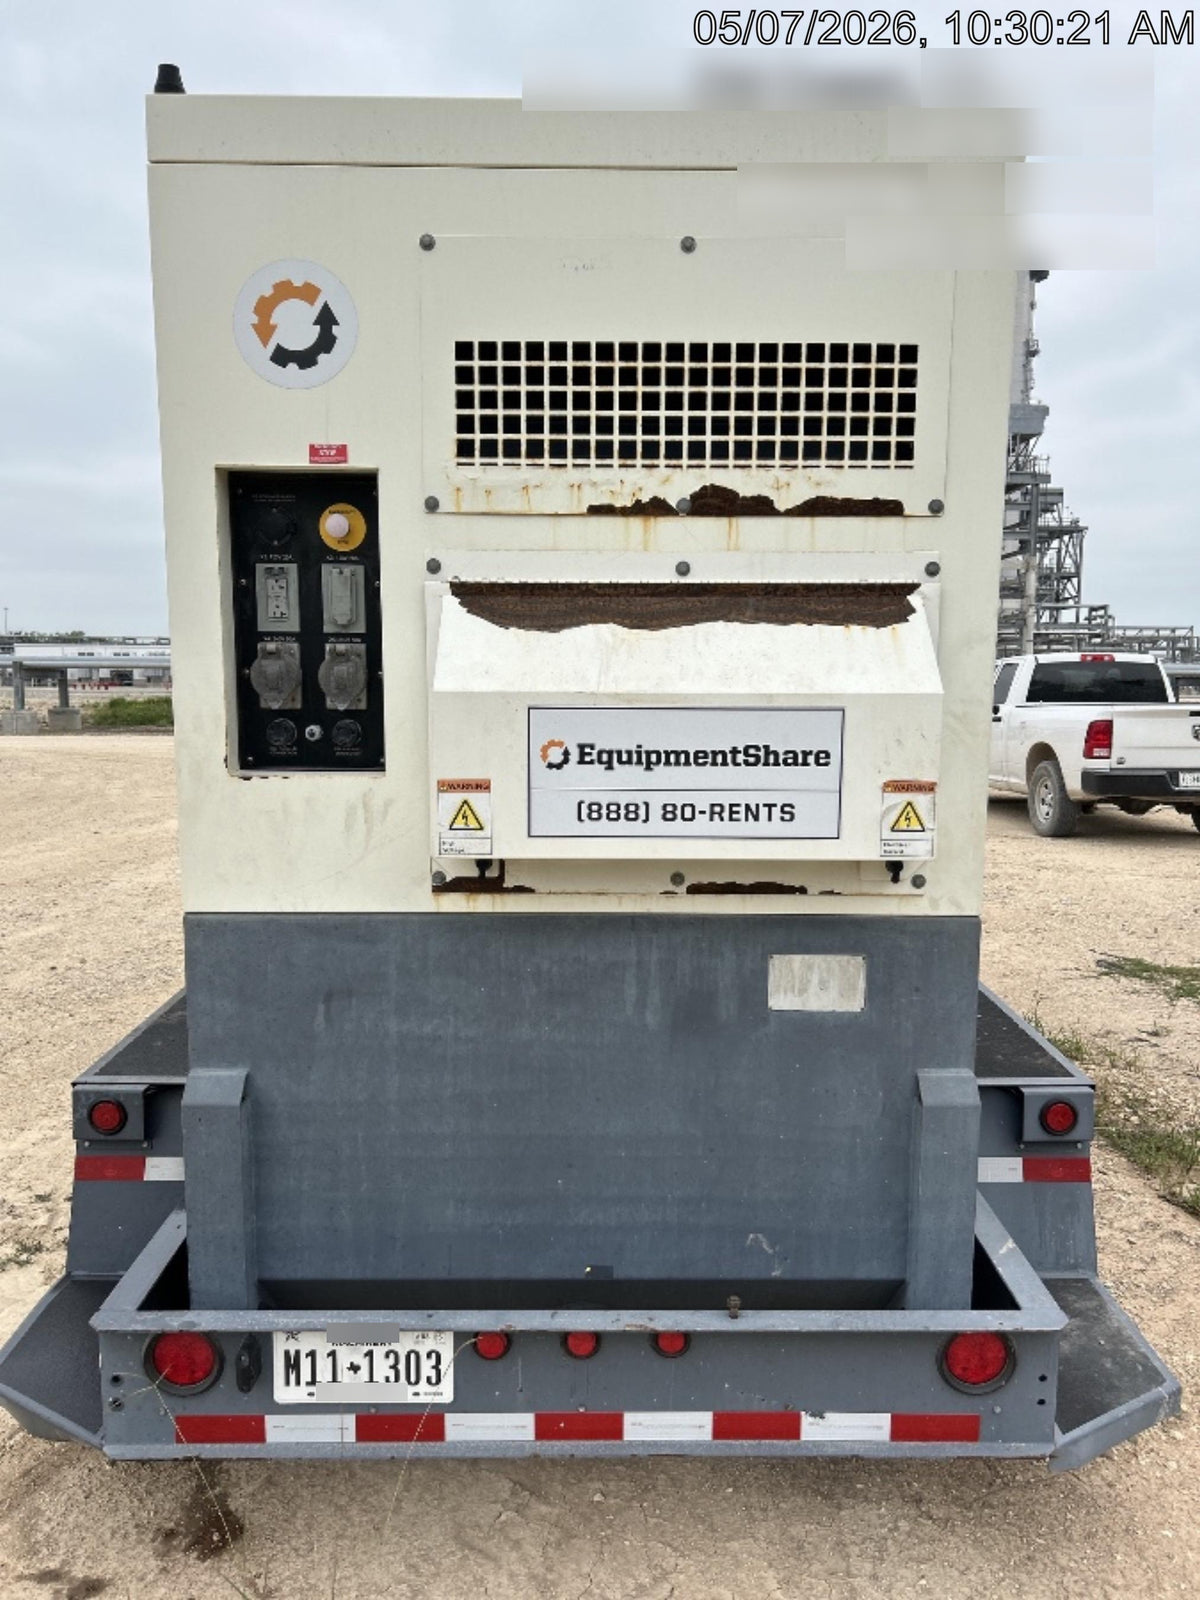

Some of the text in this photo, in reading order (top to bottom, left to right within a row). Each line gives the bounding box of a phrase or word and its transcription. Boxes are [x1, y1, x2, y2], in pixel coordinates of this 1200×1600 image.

[577, 744, 831, 771] EquipmentShare
[447, 782, 490, 791] WARNING
[894, 783, 935, 793] WARNING
[578, 801, 796, 824] (888) 80-RENTS
